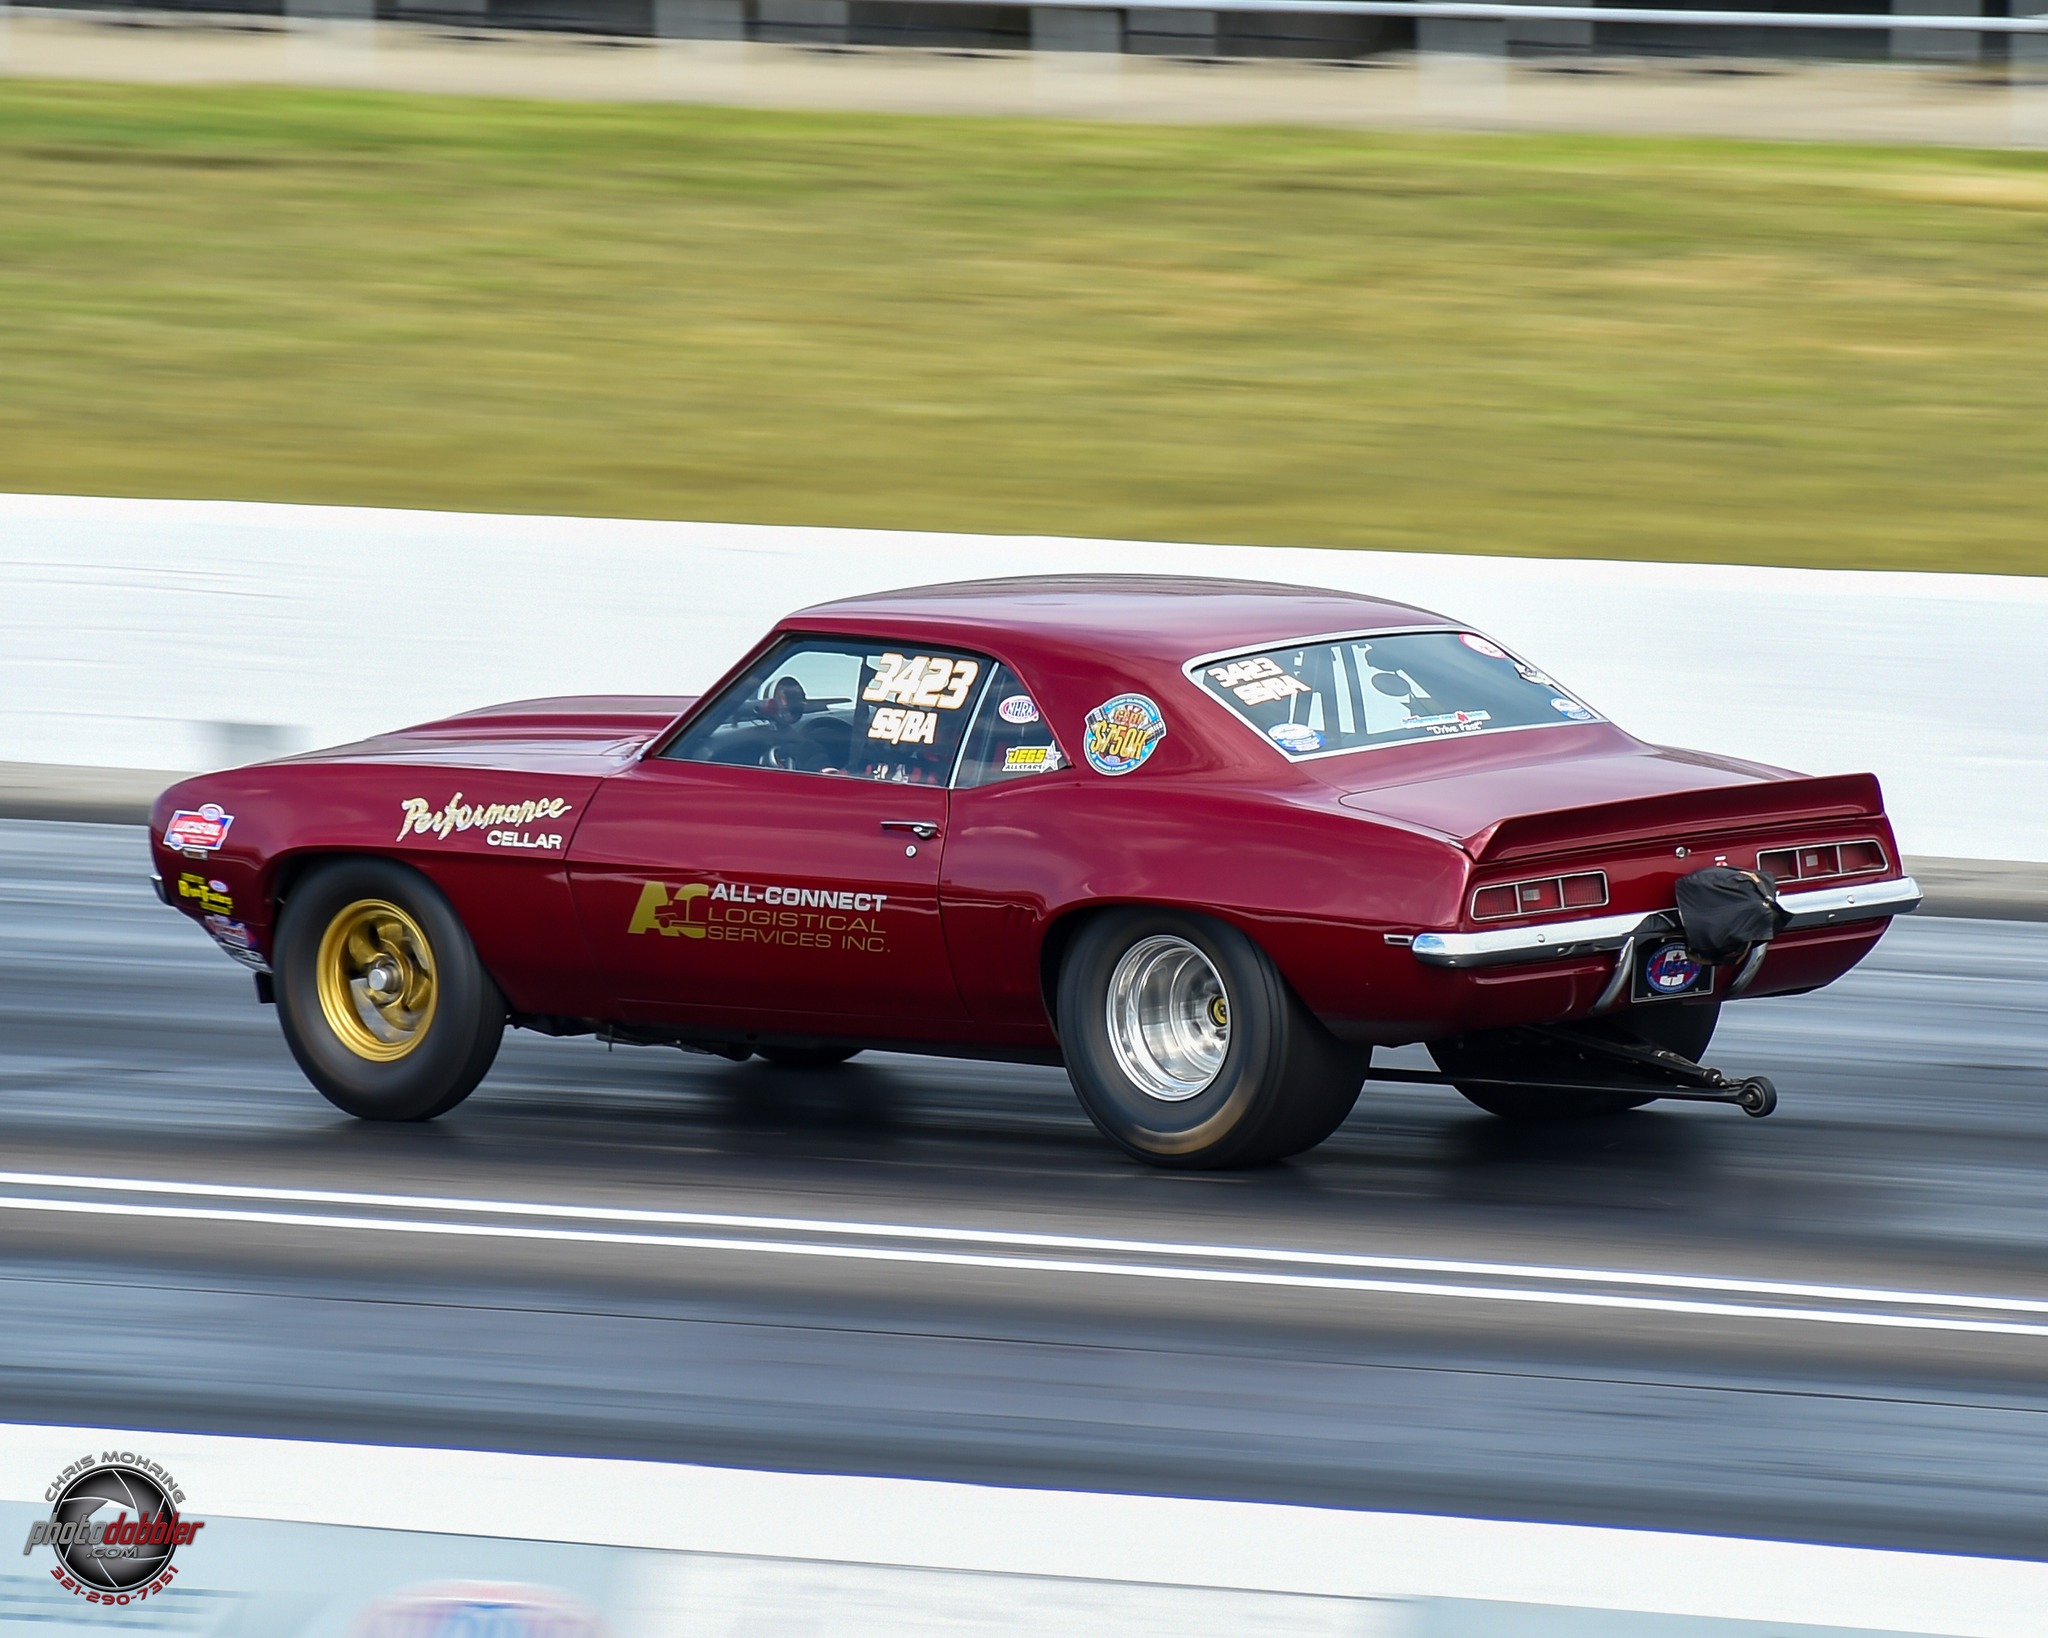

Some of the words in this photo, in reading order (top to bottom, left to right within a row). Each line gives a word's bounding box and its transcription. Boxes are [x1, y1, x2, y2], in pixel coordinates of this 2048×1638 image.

[862, 653, 979, 710] 3423
[1207, 657, 1284, 688] 3423
[1006, 701, 1034, 717] NHRA
[867, 707, 938, 745] SS/BA
[1090, 719, 1151, 760] $750K
[1007, 748, 1047, 764] JEGS
[395, 792, 572, 842] Performance
[486, 830, 562, 849] CELLAR
[710, 883, 887, 912] ALL-CONNECT
[708, 907, 887, 933] LOGISTICAL
[707, 926, 832, 948] SERVICES
[841, 935, 891, 952] INC.
